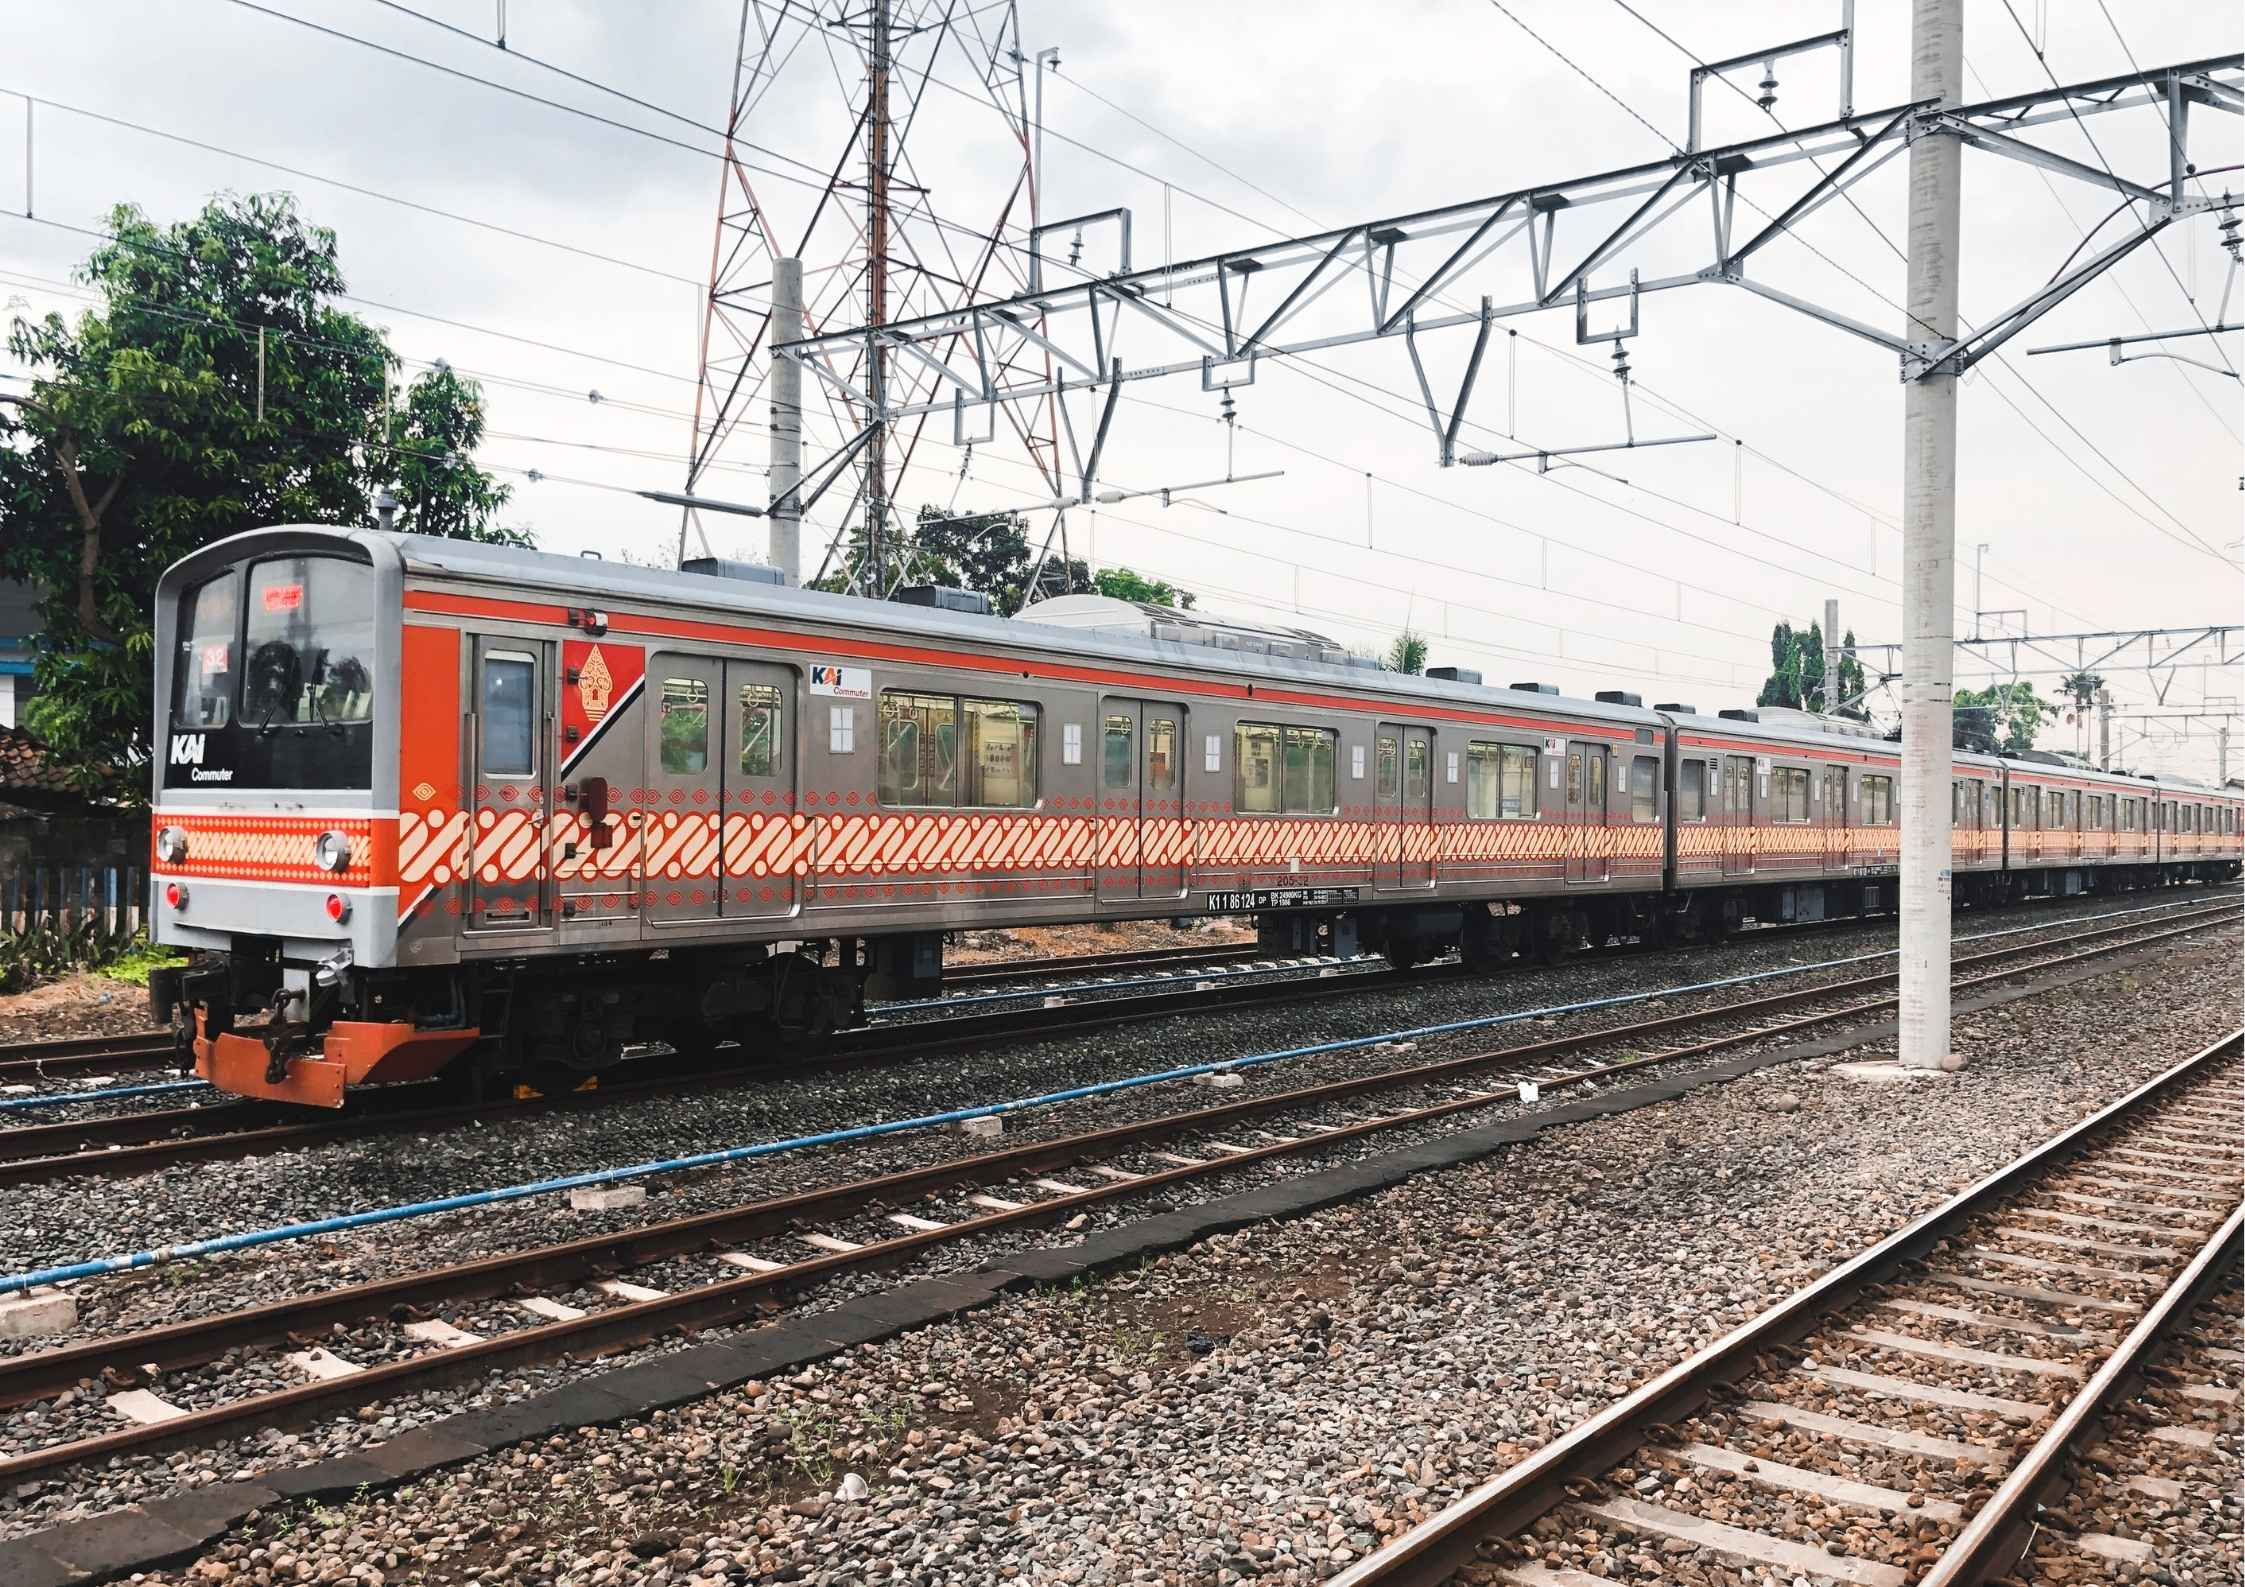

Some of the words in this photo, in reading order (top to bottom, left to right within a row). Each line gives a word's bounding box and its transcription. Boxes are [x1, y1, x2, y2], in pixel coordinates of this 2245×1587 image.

[833, 686, 869, 697] Commuter
[170, 733, 206, 765] KAI
[191, 766, 234, 782] Commuter
[1209, 894, 1220, 910] K1
[1229, 893, 1240, 909] 86
[1241, 892, 1255, 909] 124
